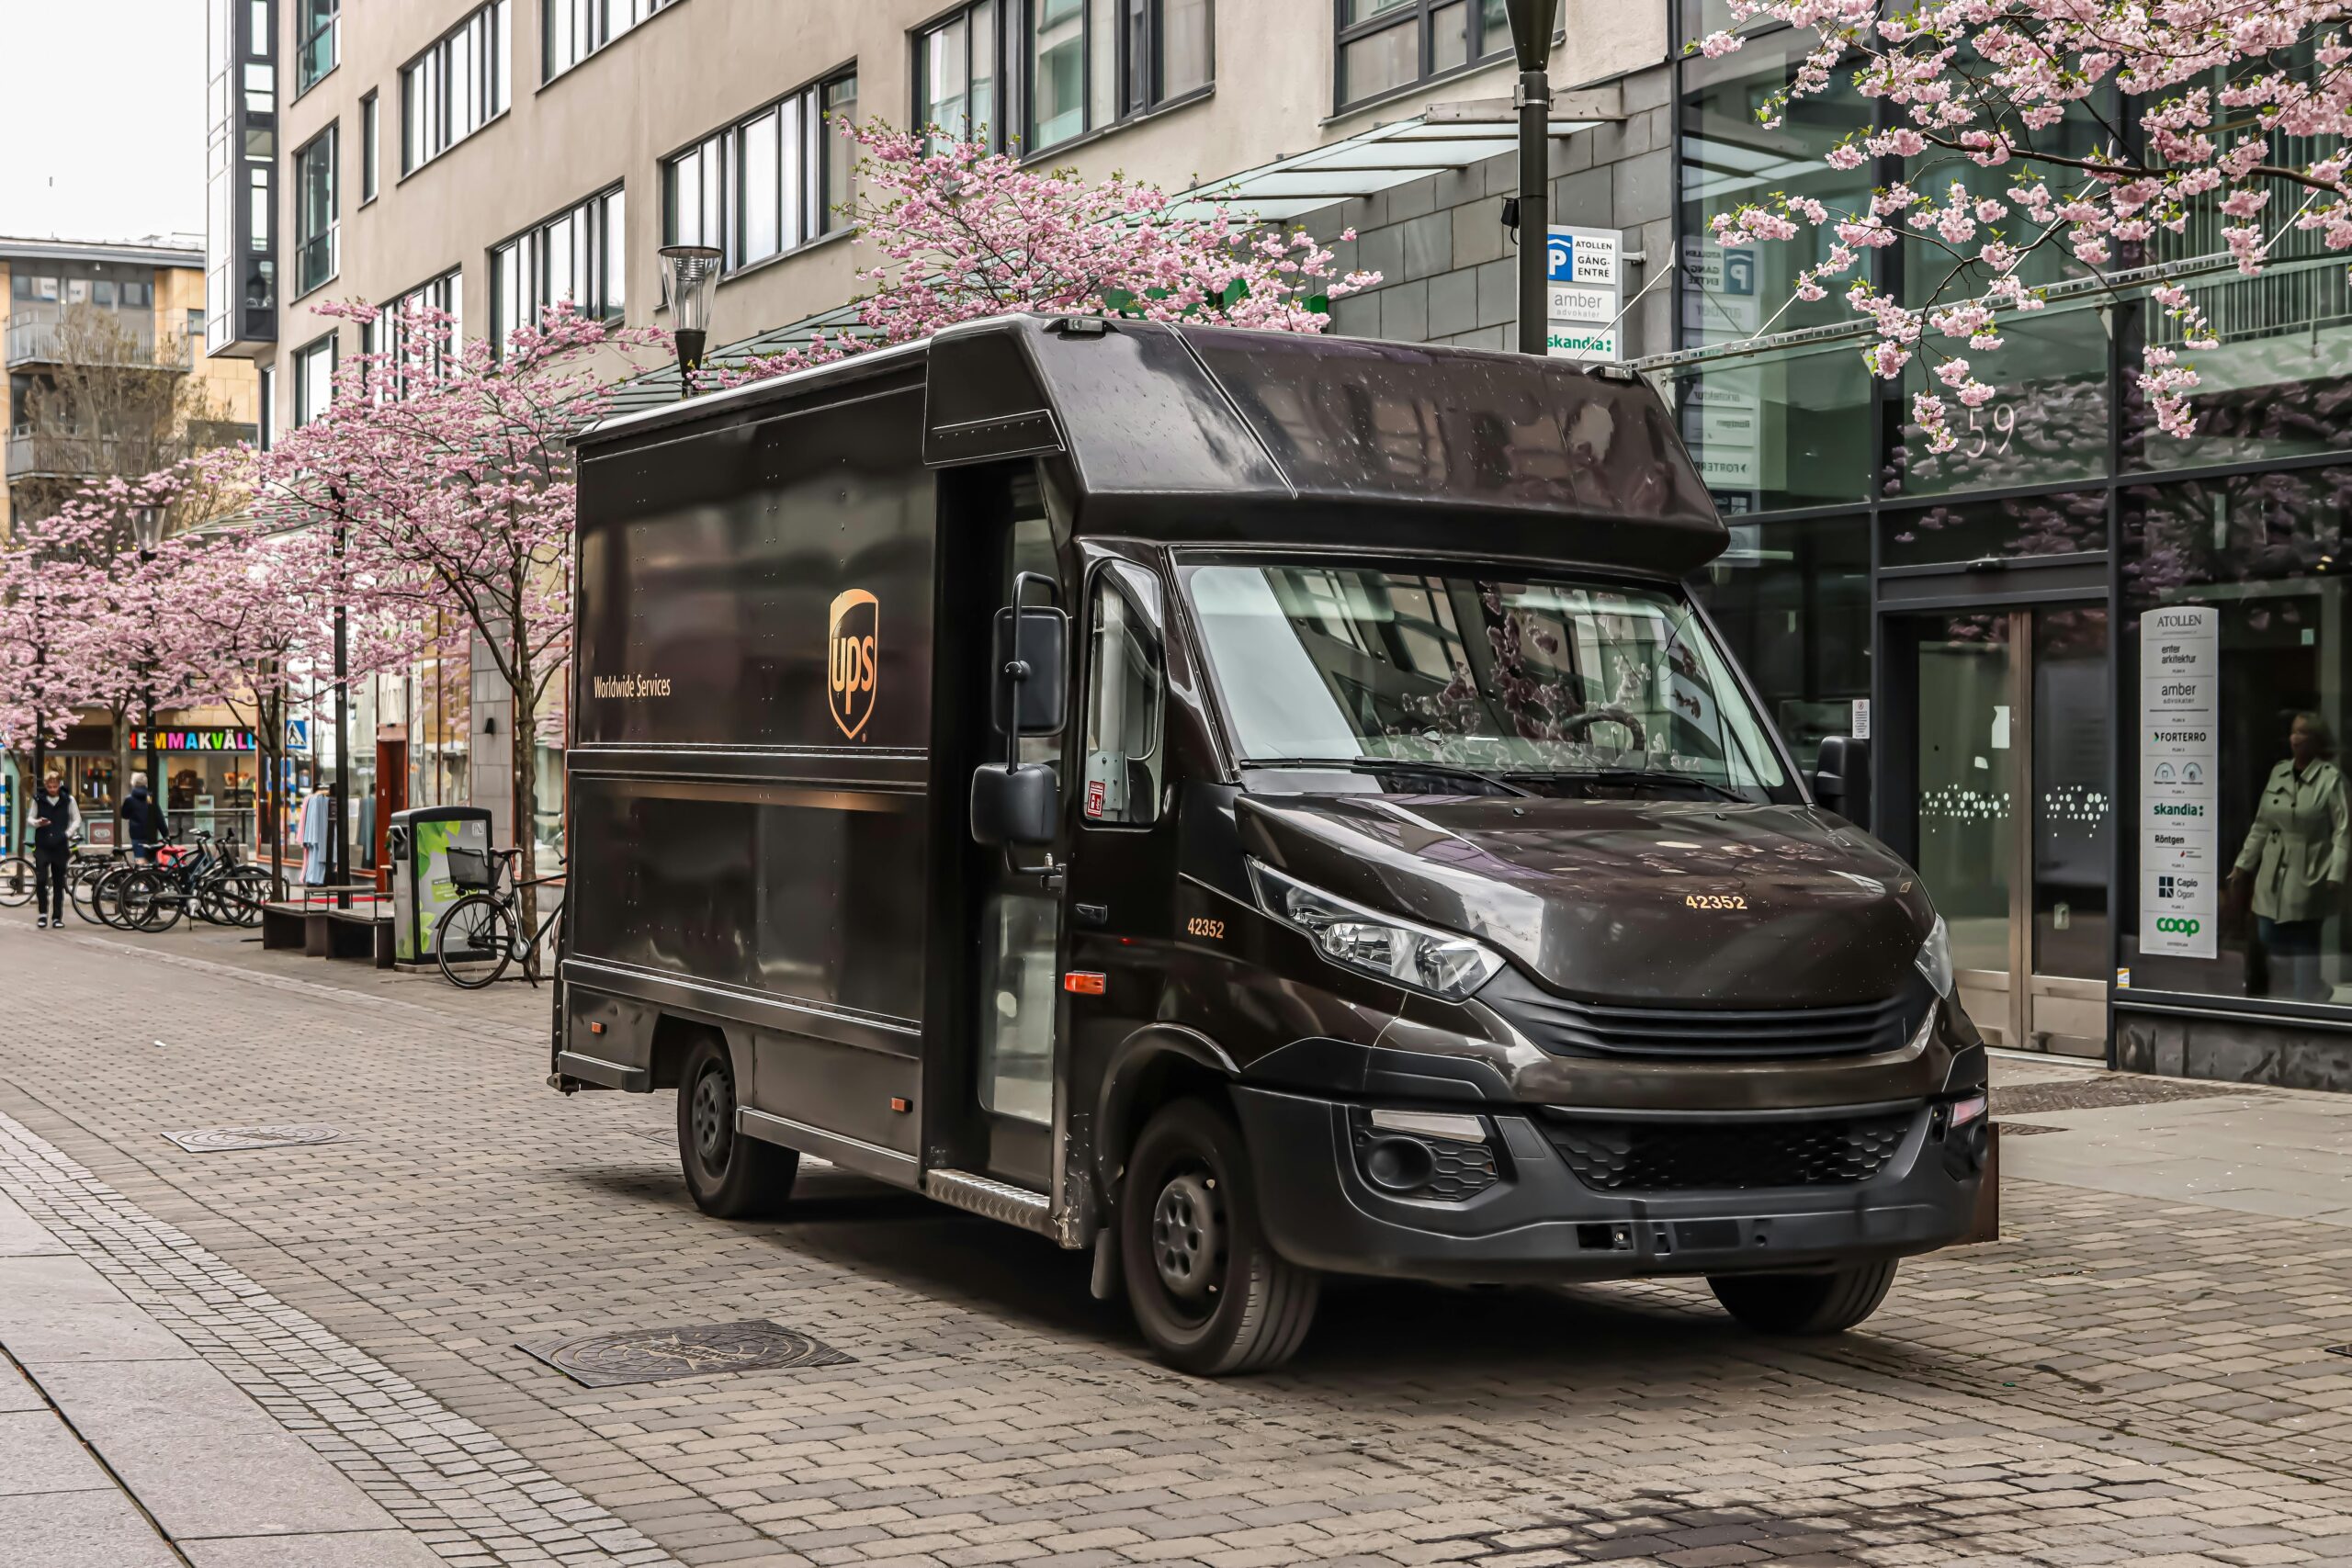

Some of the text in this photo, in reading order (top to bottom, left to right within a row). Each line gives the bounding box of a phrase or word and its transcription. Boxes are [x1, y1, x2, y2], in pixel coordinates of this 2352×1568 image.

[1576, 241, 1612, 250] ATOLLEN
[1549, 249, 1567, 276] P
[1577, 254, 1611, 265] GÅNG-
[1577, 267, 1610, 277] ENTRÉ
[1555, 292, 1602, 309] amber
[1966, 403, 2015, 457] 59
[2157, 615, 2201, 627] ATOLLEN
[2162, 644, 2180, 654] enter
[831, 636, 874, 715] ups
[594, 673, 671, 698] Worldwide Services
[2161, 682, 2196, 696] amber
[2160, 732, 2207, 742] FORTERRO
[2154, 834, 2185, 845] Röntgen
[2177, 877, 2198, 889] Capio
[1685, 895, 1748, 909] 42352
[1187, 918, 1225, 939] 42352
[2156, 917, 2200, 938] coop
